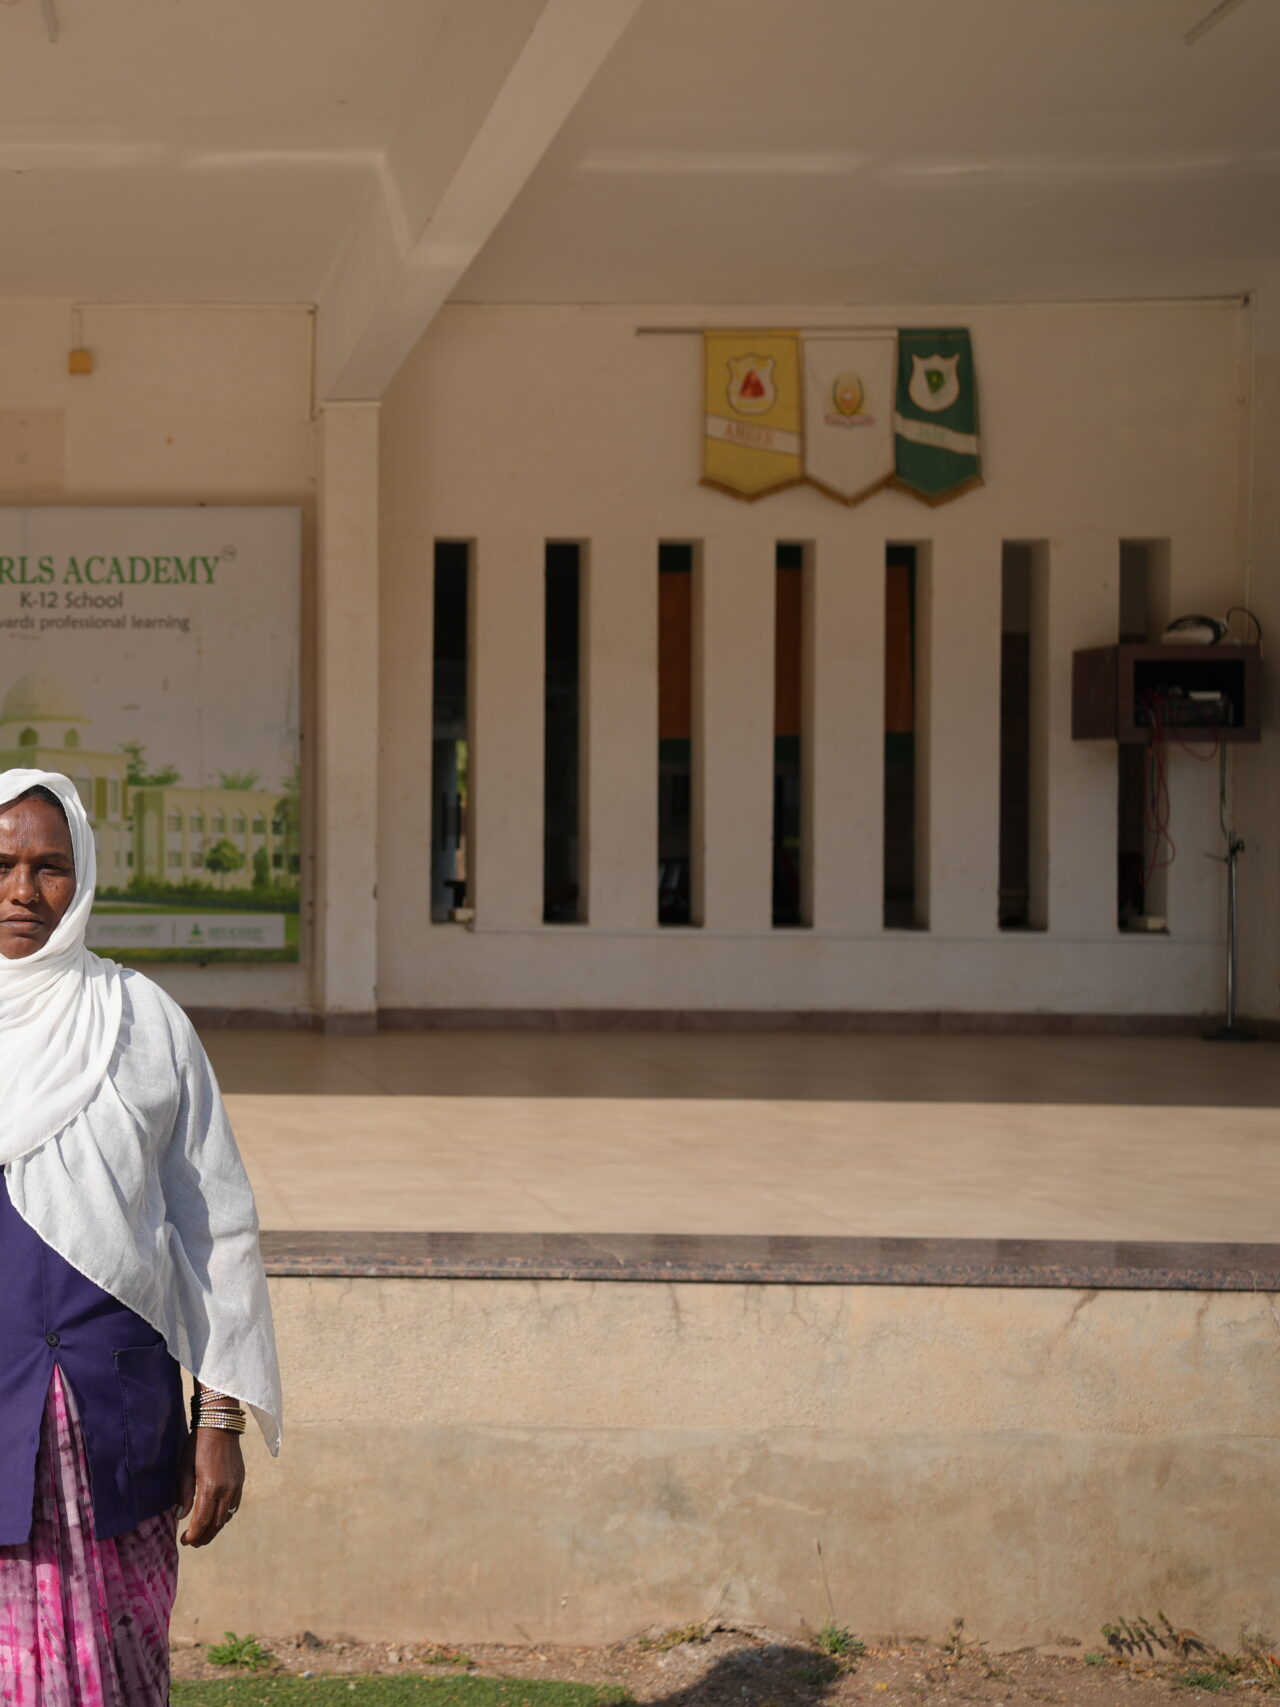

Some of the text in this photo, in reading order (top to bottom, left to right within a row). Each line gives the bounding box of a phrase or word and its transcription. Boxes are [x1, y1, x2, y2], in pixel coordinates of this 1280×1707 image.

[62, 556, 221, 585] ACADEMY
[20, 591, 124, 609] K-12 School
[40, 614, 126, 633] professional
[131, 614, 191, 633] learning
